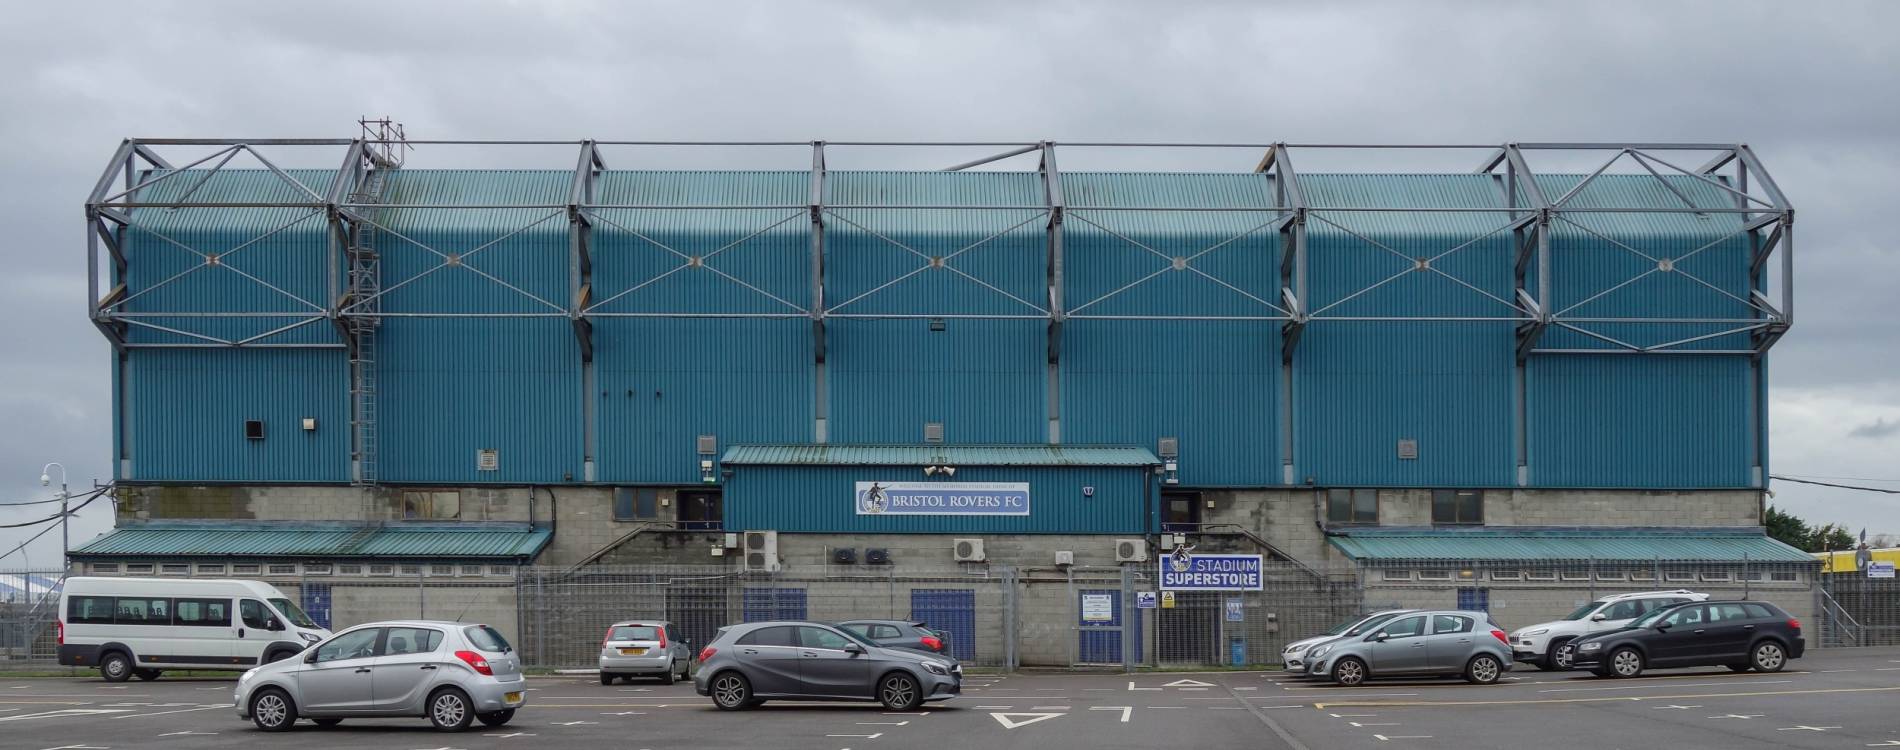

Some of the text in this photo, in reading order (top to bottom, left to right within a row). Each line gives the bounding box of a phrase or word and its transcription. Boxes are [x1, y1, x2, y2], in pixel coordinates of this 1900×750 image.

[893, 496, 1022, 506] BRISTOL ROVERS FC
[1197, 560, 1257, 571] STADIUM
[1166, 573, 1257, 585] SUPERSTORE
